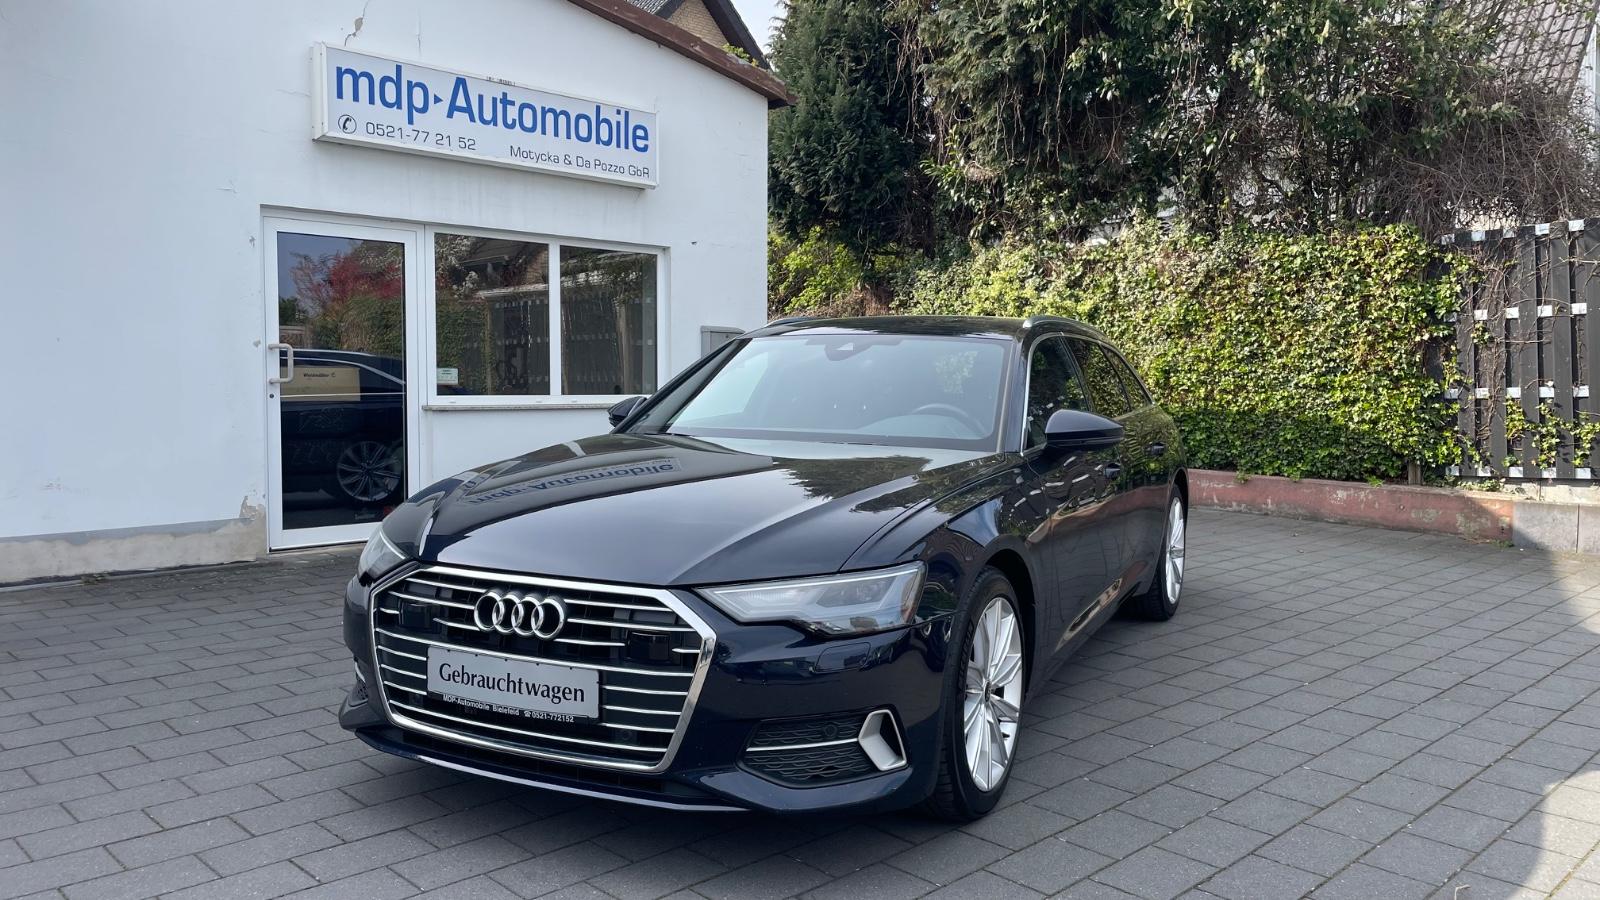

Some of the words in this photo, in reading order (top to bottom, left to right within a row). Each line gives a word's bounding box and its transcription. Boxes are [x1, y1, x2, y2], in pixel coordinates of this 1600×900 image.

[366, 122, 430, 143] 0521-77
[435, 133, 451, 147] 21
[458, 136, 477, 150] 52
[509, 145, 560, 164] Motycka
[564, 154, 573, 166] &
[576, 156, 591, 169] Da
[594, 158, 625, 175] Pozzo
[628, 165, 650, 179] GbR
[439, 662, 585, 705] Gebrauchtwagen
